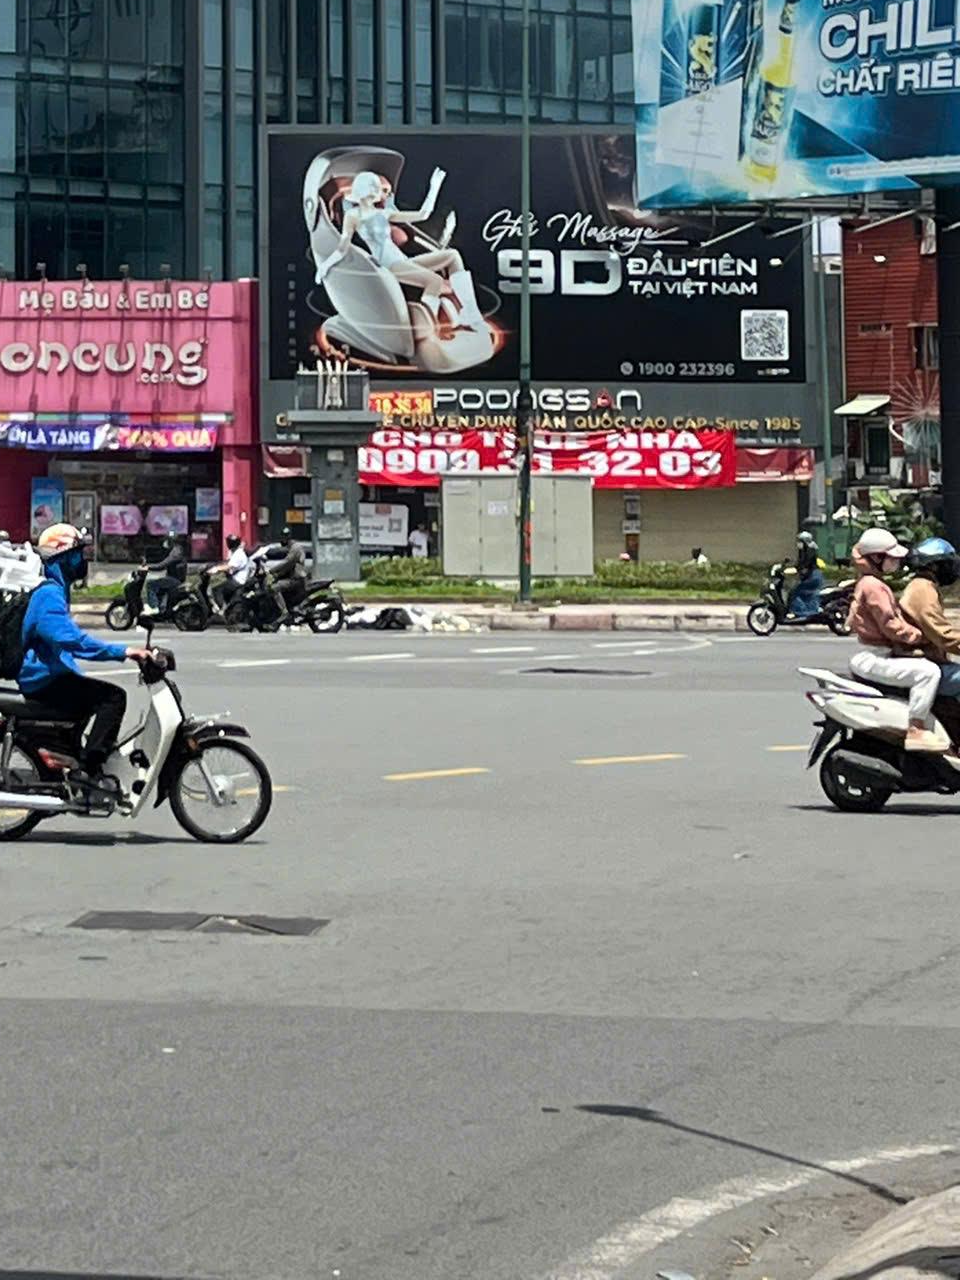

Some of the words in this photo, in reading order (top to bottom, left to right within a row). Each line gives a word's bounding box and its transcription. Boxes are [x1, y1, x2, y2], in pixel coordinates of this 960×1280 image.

[819, 58, 890, 94] CHẤT
[897, 52, 960, 91] RIÊ
[547, 212, 679, 256] Massage
[497, 249, 622, 295] 9D
[691, 253, 757, 276] TIÊN
[18, 290, 55, 314] Mẹ
[116, 295, 130, 310] &
[135, 290, 172, 310] Em
[177, 285, 209, 310] Bé
[628, 280, 661, 298] TẠI
[663, 278, 708, 298] VIỆT
[711, 281, 758, 295] NAM
[638, 362, 676, 376] 1900
[679, 362, 735, 377] 232396
[630, 416, 667, 429] CAO
[715, 417, 759, 430] Since
[765, 417, 801, 430] 1985
[372, 431, 462, 448] CHO
